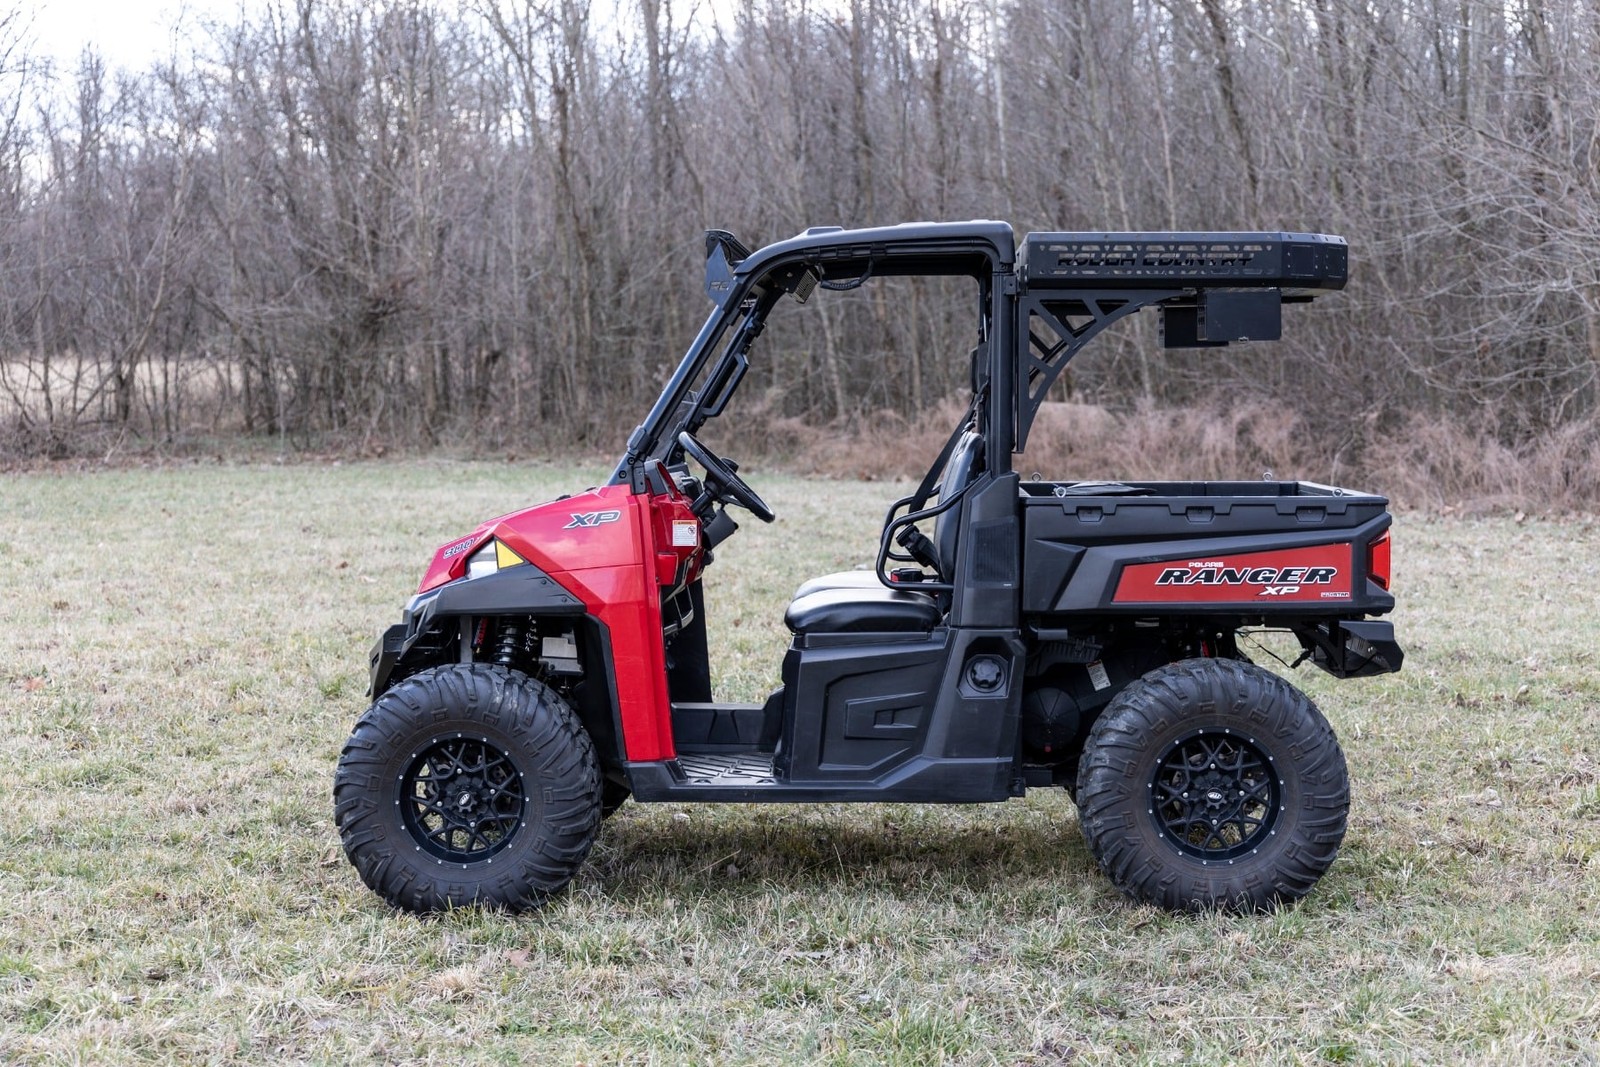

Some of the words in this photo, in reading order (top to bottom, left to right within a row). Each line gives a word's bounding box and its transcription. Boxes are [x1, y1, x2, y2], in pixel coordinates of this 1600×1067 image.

[1057, 252, 1138, 267] ROUGH
[1141, 252, 1255, 267] COUNTRY
[562, 510, 621, 529] XP
[1155, 566, 1338, 586] RANGER
[1257, 585, 1301, 596] XP
